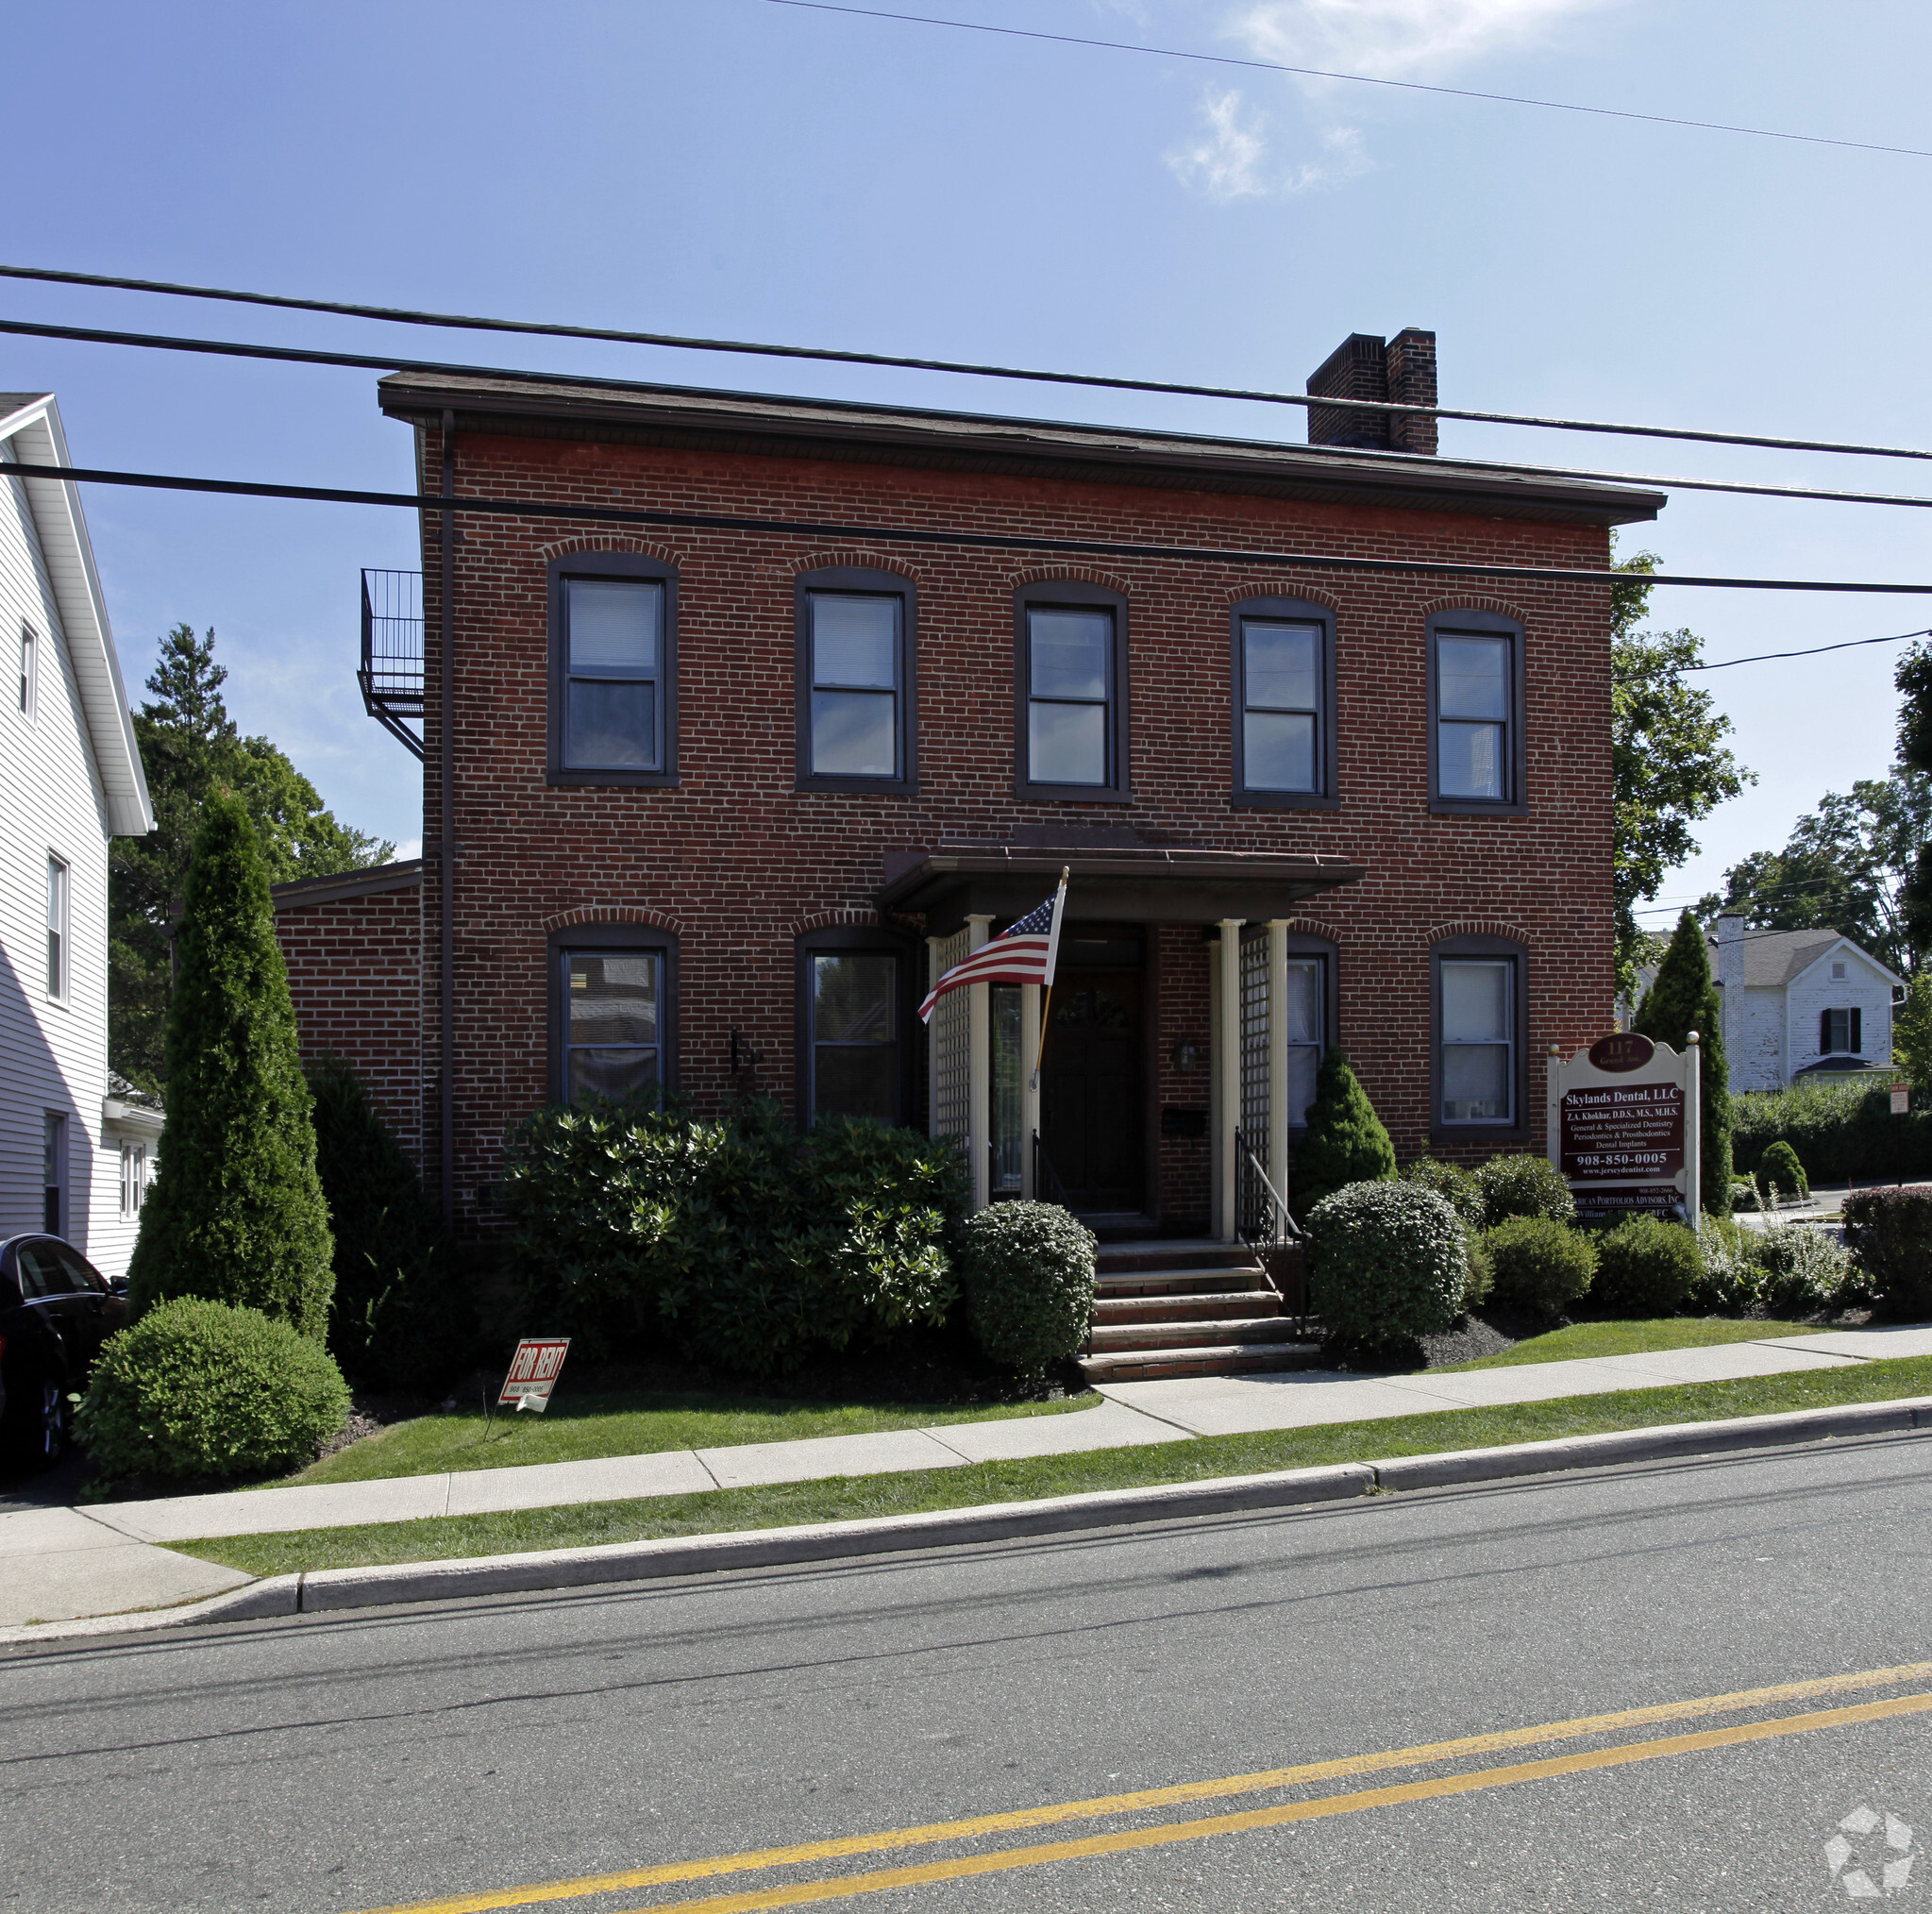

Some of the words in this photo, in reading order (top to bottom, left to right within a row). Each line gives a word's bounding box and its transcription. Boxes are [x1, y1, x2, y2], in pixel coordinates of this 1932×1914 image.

[1608, 1040, 1634, 1055] 117
[1566, 1093, 1611, 1107] Skylands
[1614, 1089, 1651, 1102] Dental,
[1654, 1087, 1679, 1100] LLC
[1567, 1113, 1581, 1121] Z.A.
[1655, 1107, 1678, 1116] M.H.S.
[1604, 1121, 1641, 1131] Specialized
[1643, 1119, 1673, 1129] Dentistry
[1573, 1132, 1612, 1140] Periodontics
[1622, 1130, 1671, 1138] Prosthodontics
[1619, 1140, 1647, 1149] Implants
[1577, 1152, 1667, 1166] 908-850-0005
[1583, 1166, 1660, 1175] www.jerseydentist.com
[1597, 1196, 1635, 1205] PORTFOLIOS
[511, 1347, 538, 1380] FOR
[532, 1346, 565, 1379] RENT
